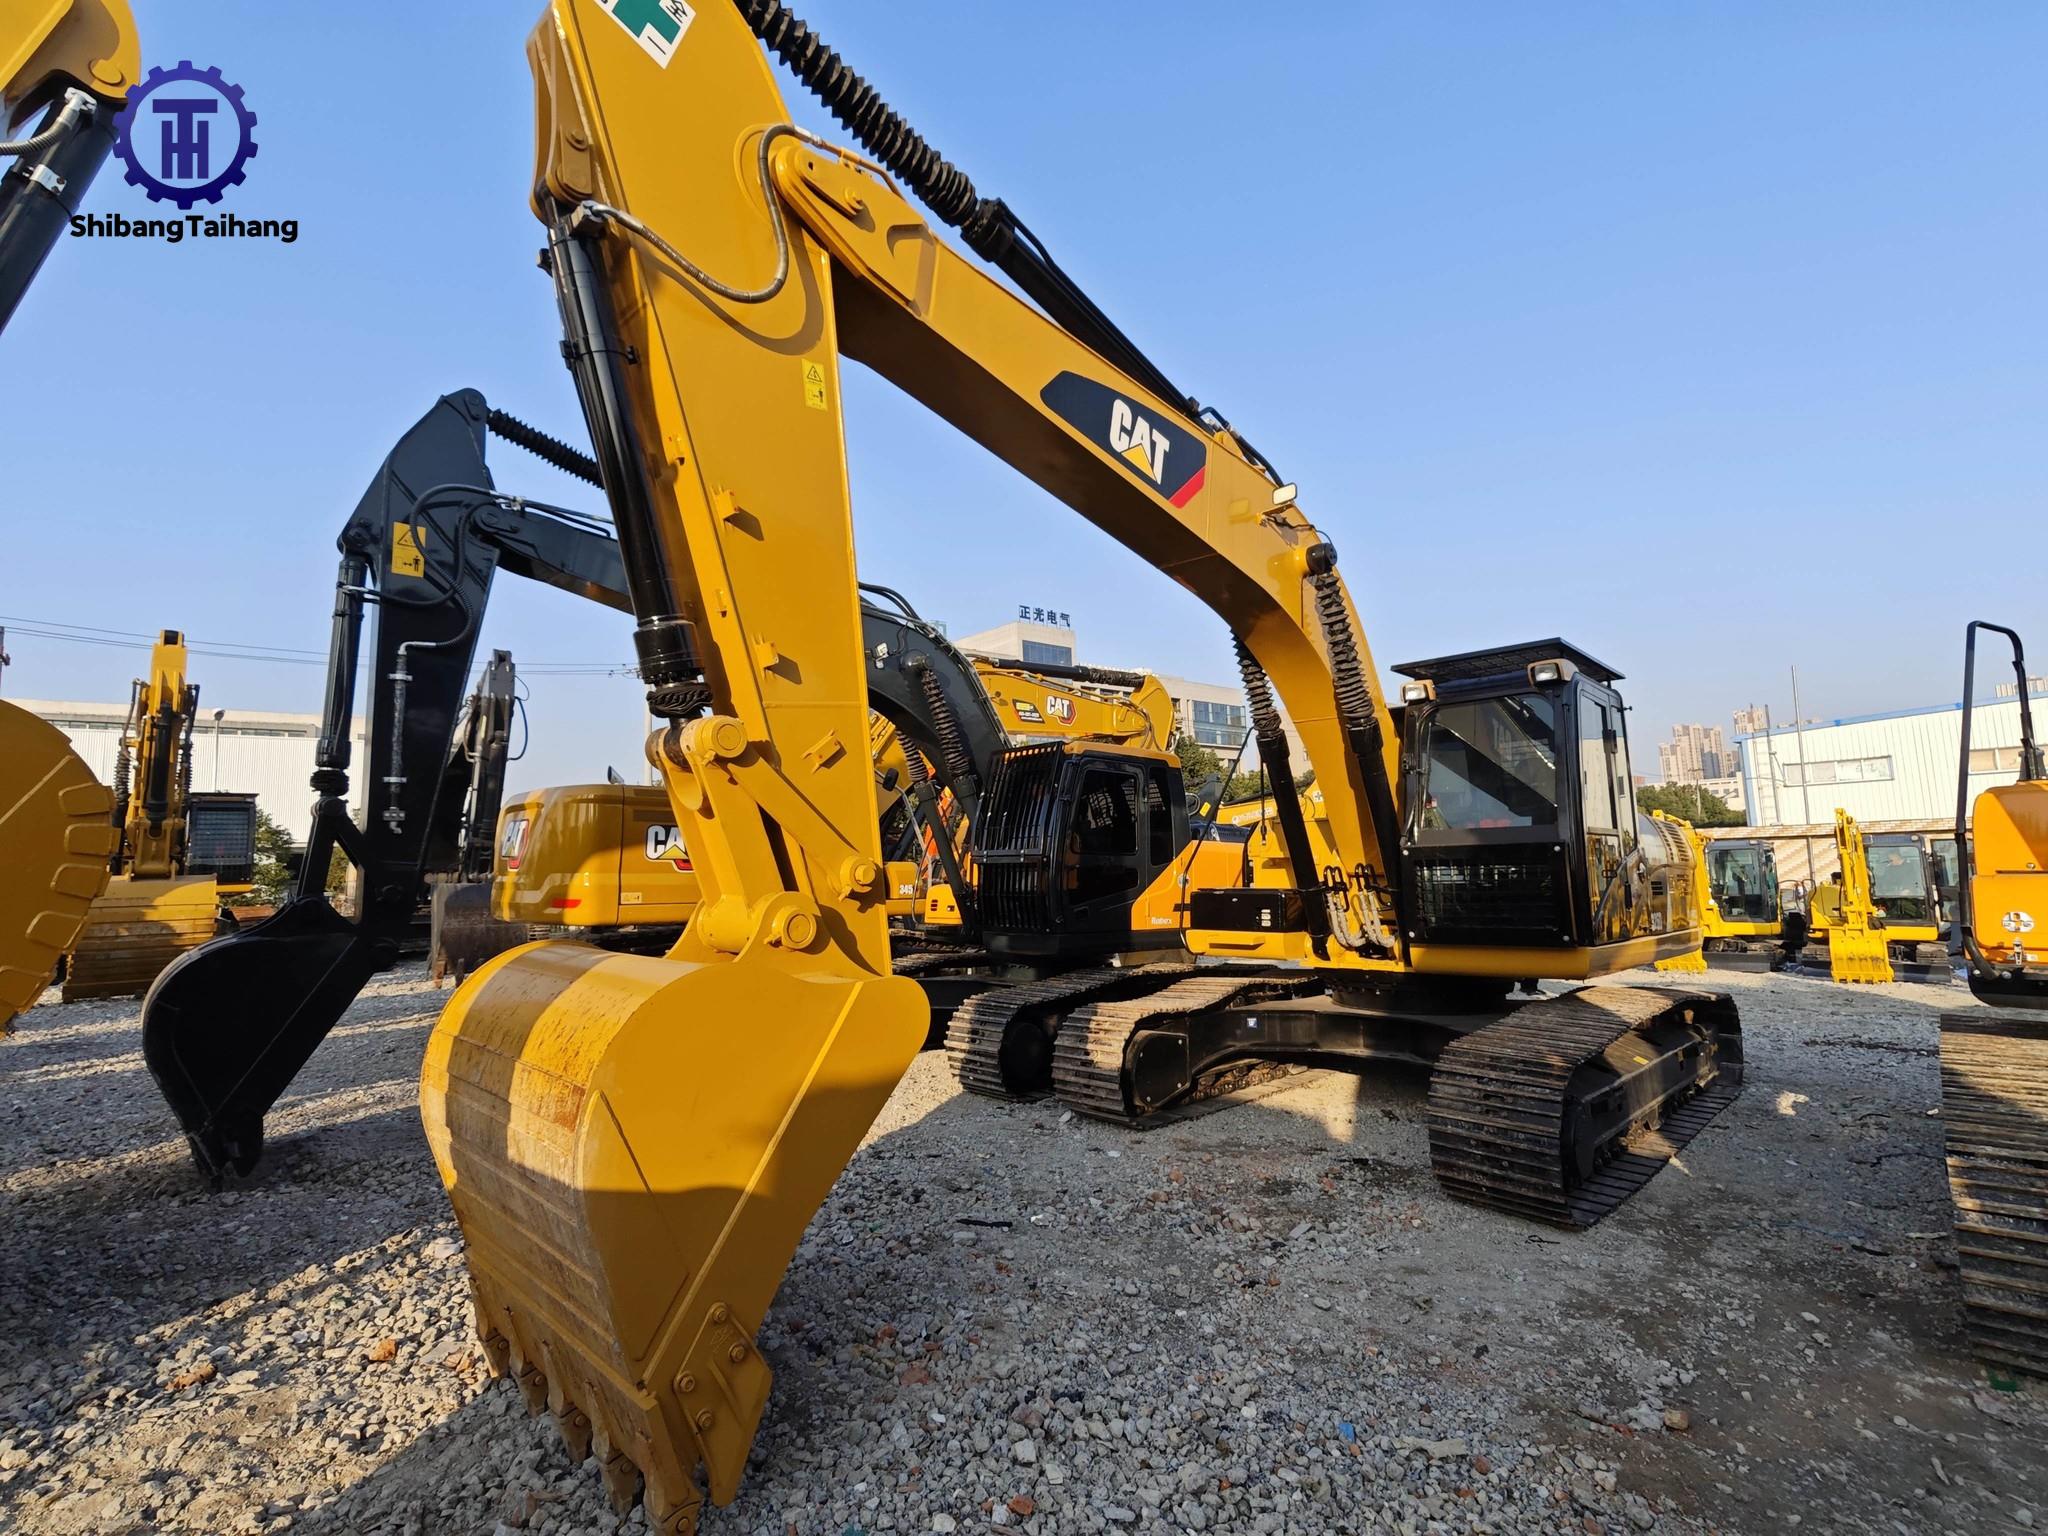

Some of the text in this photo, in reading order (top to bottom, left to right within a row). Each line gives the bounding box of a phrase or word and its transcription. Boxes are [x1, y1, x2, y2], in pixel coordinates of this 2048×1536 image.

[1109, 398, 1170, 485] CAT
[1019, 604, 1070, 628] 正光电气
[1046, 695, 1070, 719] CAT
[646, 824, 689, 860] CA
